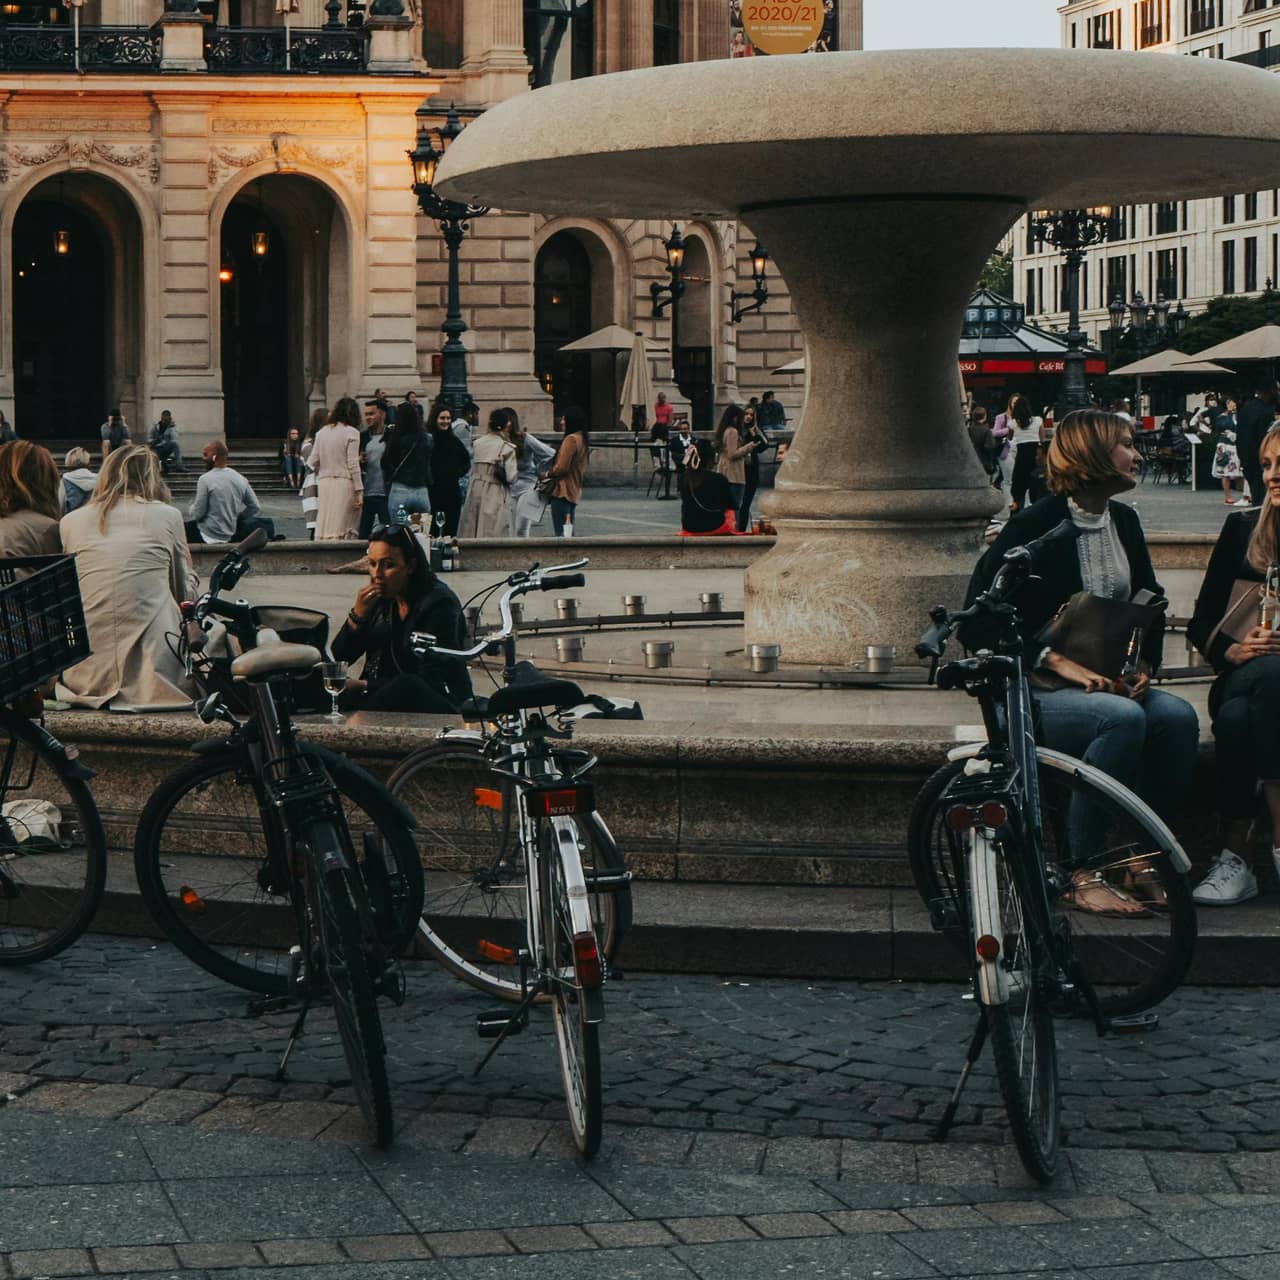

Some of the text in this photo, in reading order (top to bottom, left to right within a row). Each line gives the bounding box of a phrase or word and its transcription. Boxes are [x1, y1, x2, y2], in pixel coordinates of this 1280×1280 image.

[748, 5, 817, 22] 2020/21
[969, 311, 978, 321] P
[986, 311, 994, 321] P
